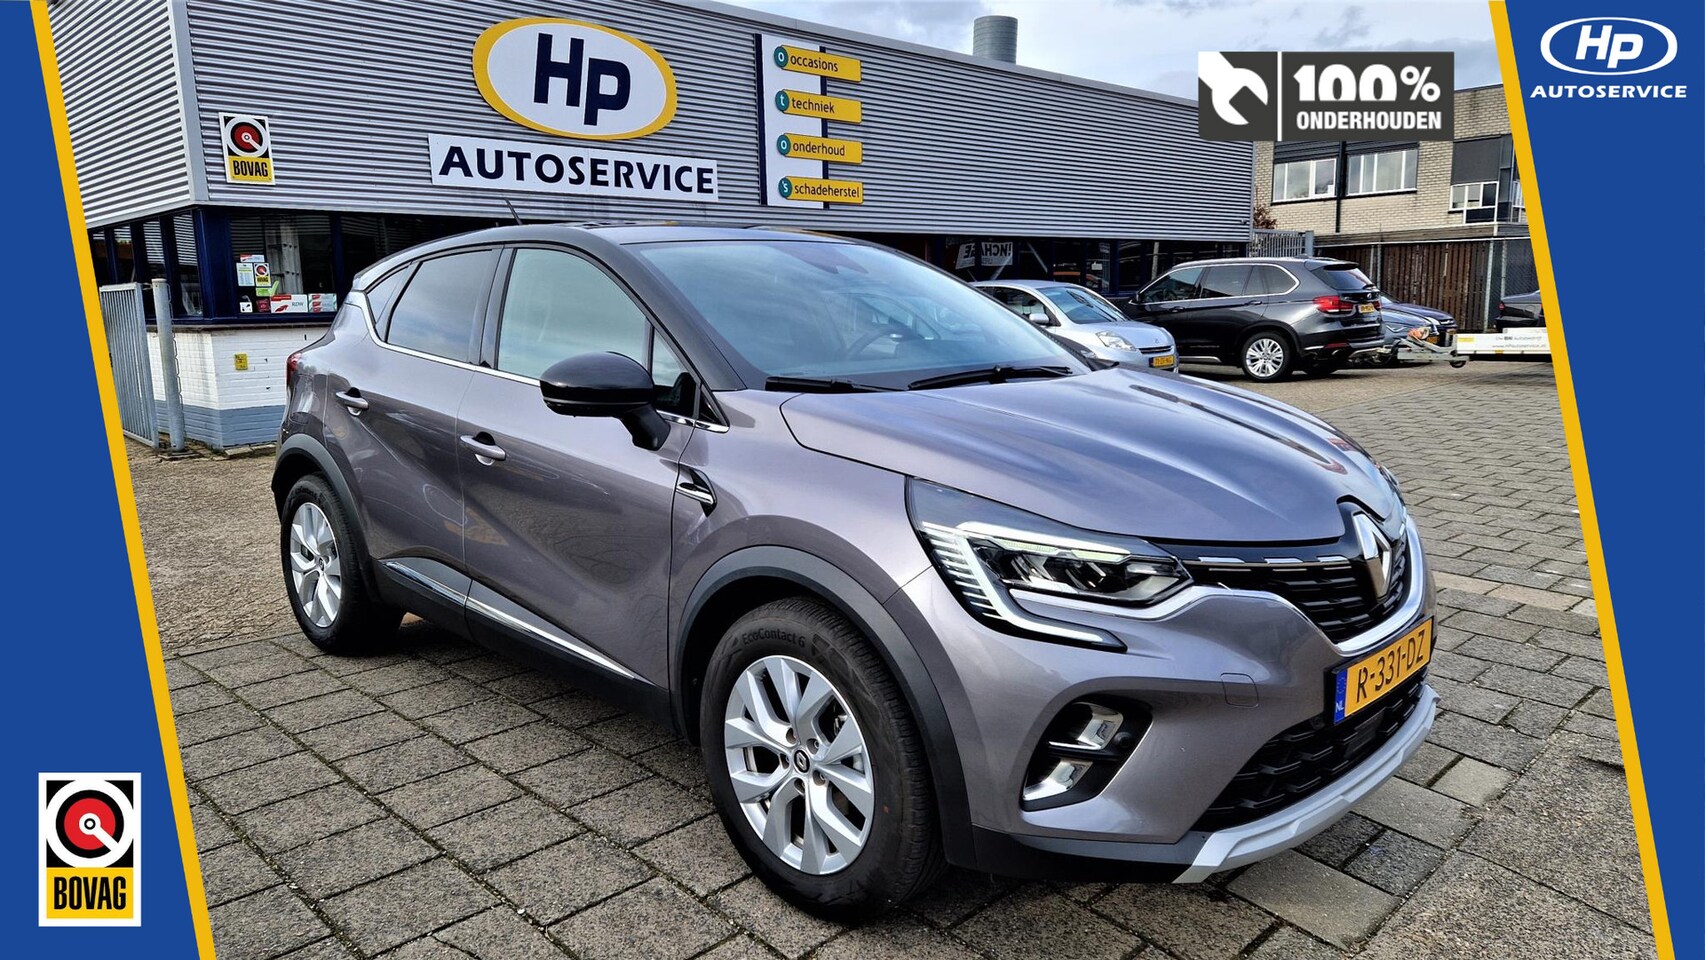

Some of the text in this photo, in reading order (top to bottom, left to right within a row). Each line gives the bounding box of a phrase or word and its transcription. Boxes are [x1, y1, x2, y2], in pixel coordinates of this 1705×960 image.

[790, 55, 839, 72] occasions
[533, 32, 631, 126] Hp
[791, 98, 835, 114] techniek
[793, 141, 845, 156] onderhoud
[233, 160, 268, 177] BOVAG
[438, 145, 714, 194] AUTOSERVICE
[794, 183, 860, 198] schadeherstel
[742, 628, 806, 648] EcoContact 6
[1357, 630, 1425, 703] R-331-DZ
[1335, 700, 1344, 713] NL
